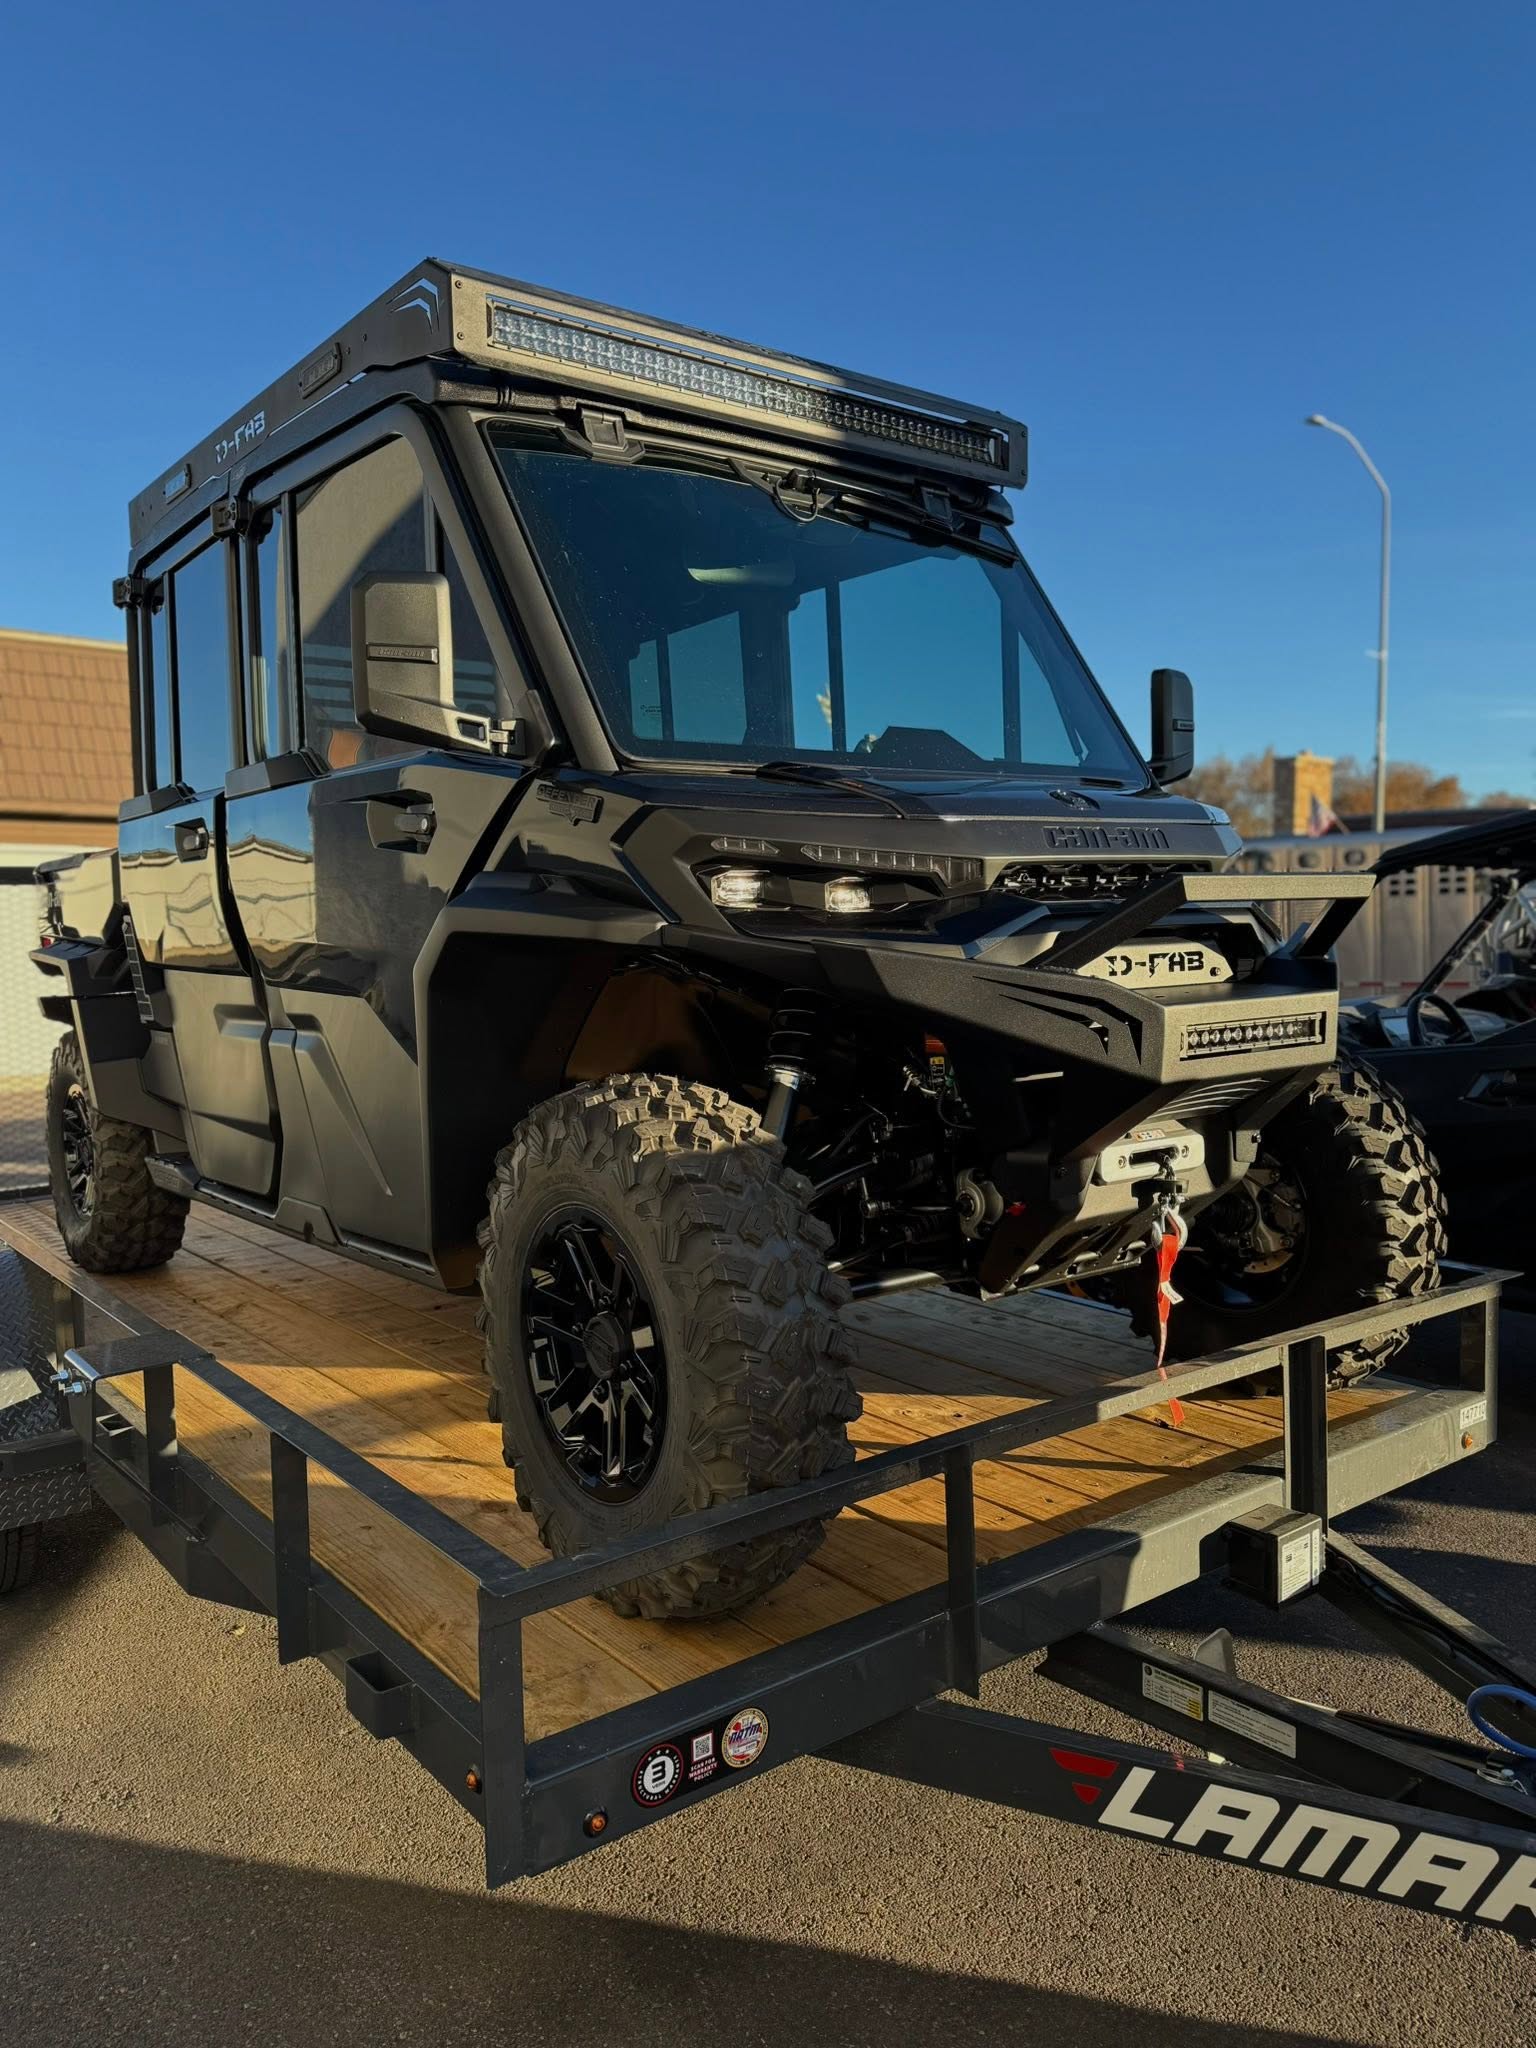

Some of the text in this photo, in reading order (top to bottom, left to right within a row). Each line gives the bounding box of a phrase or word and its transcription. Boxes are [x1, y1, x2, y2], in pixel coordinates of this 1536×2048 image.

[214, 409, 265, 464] D-FAB
[1104, 951, 1204, 978] D-FAB
[651, 1760, 666, 1784] 3
[688, 1762, 718, 1779] WARRANTY
[693, 1770, 713, 1782] POLICY
